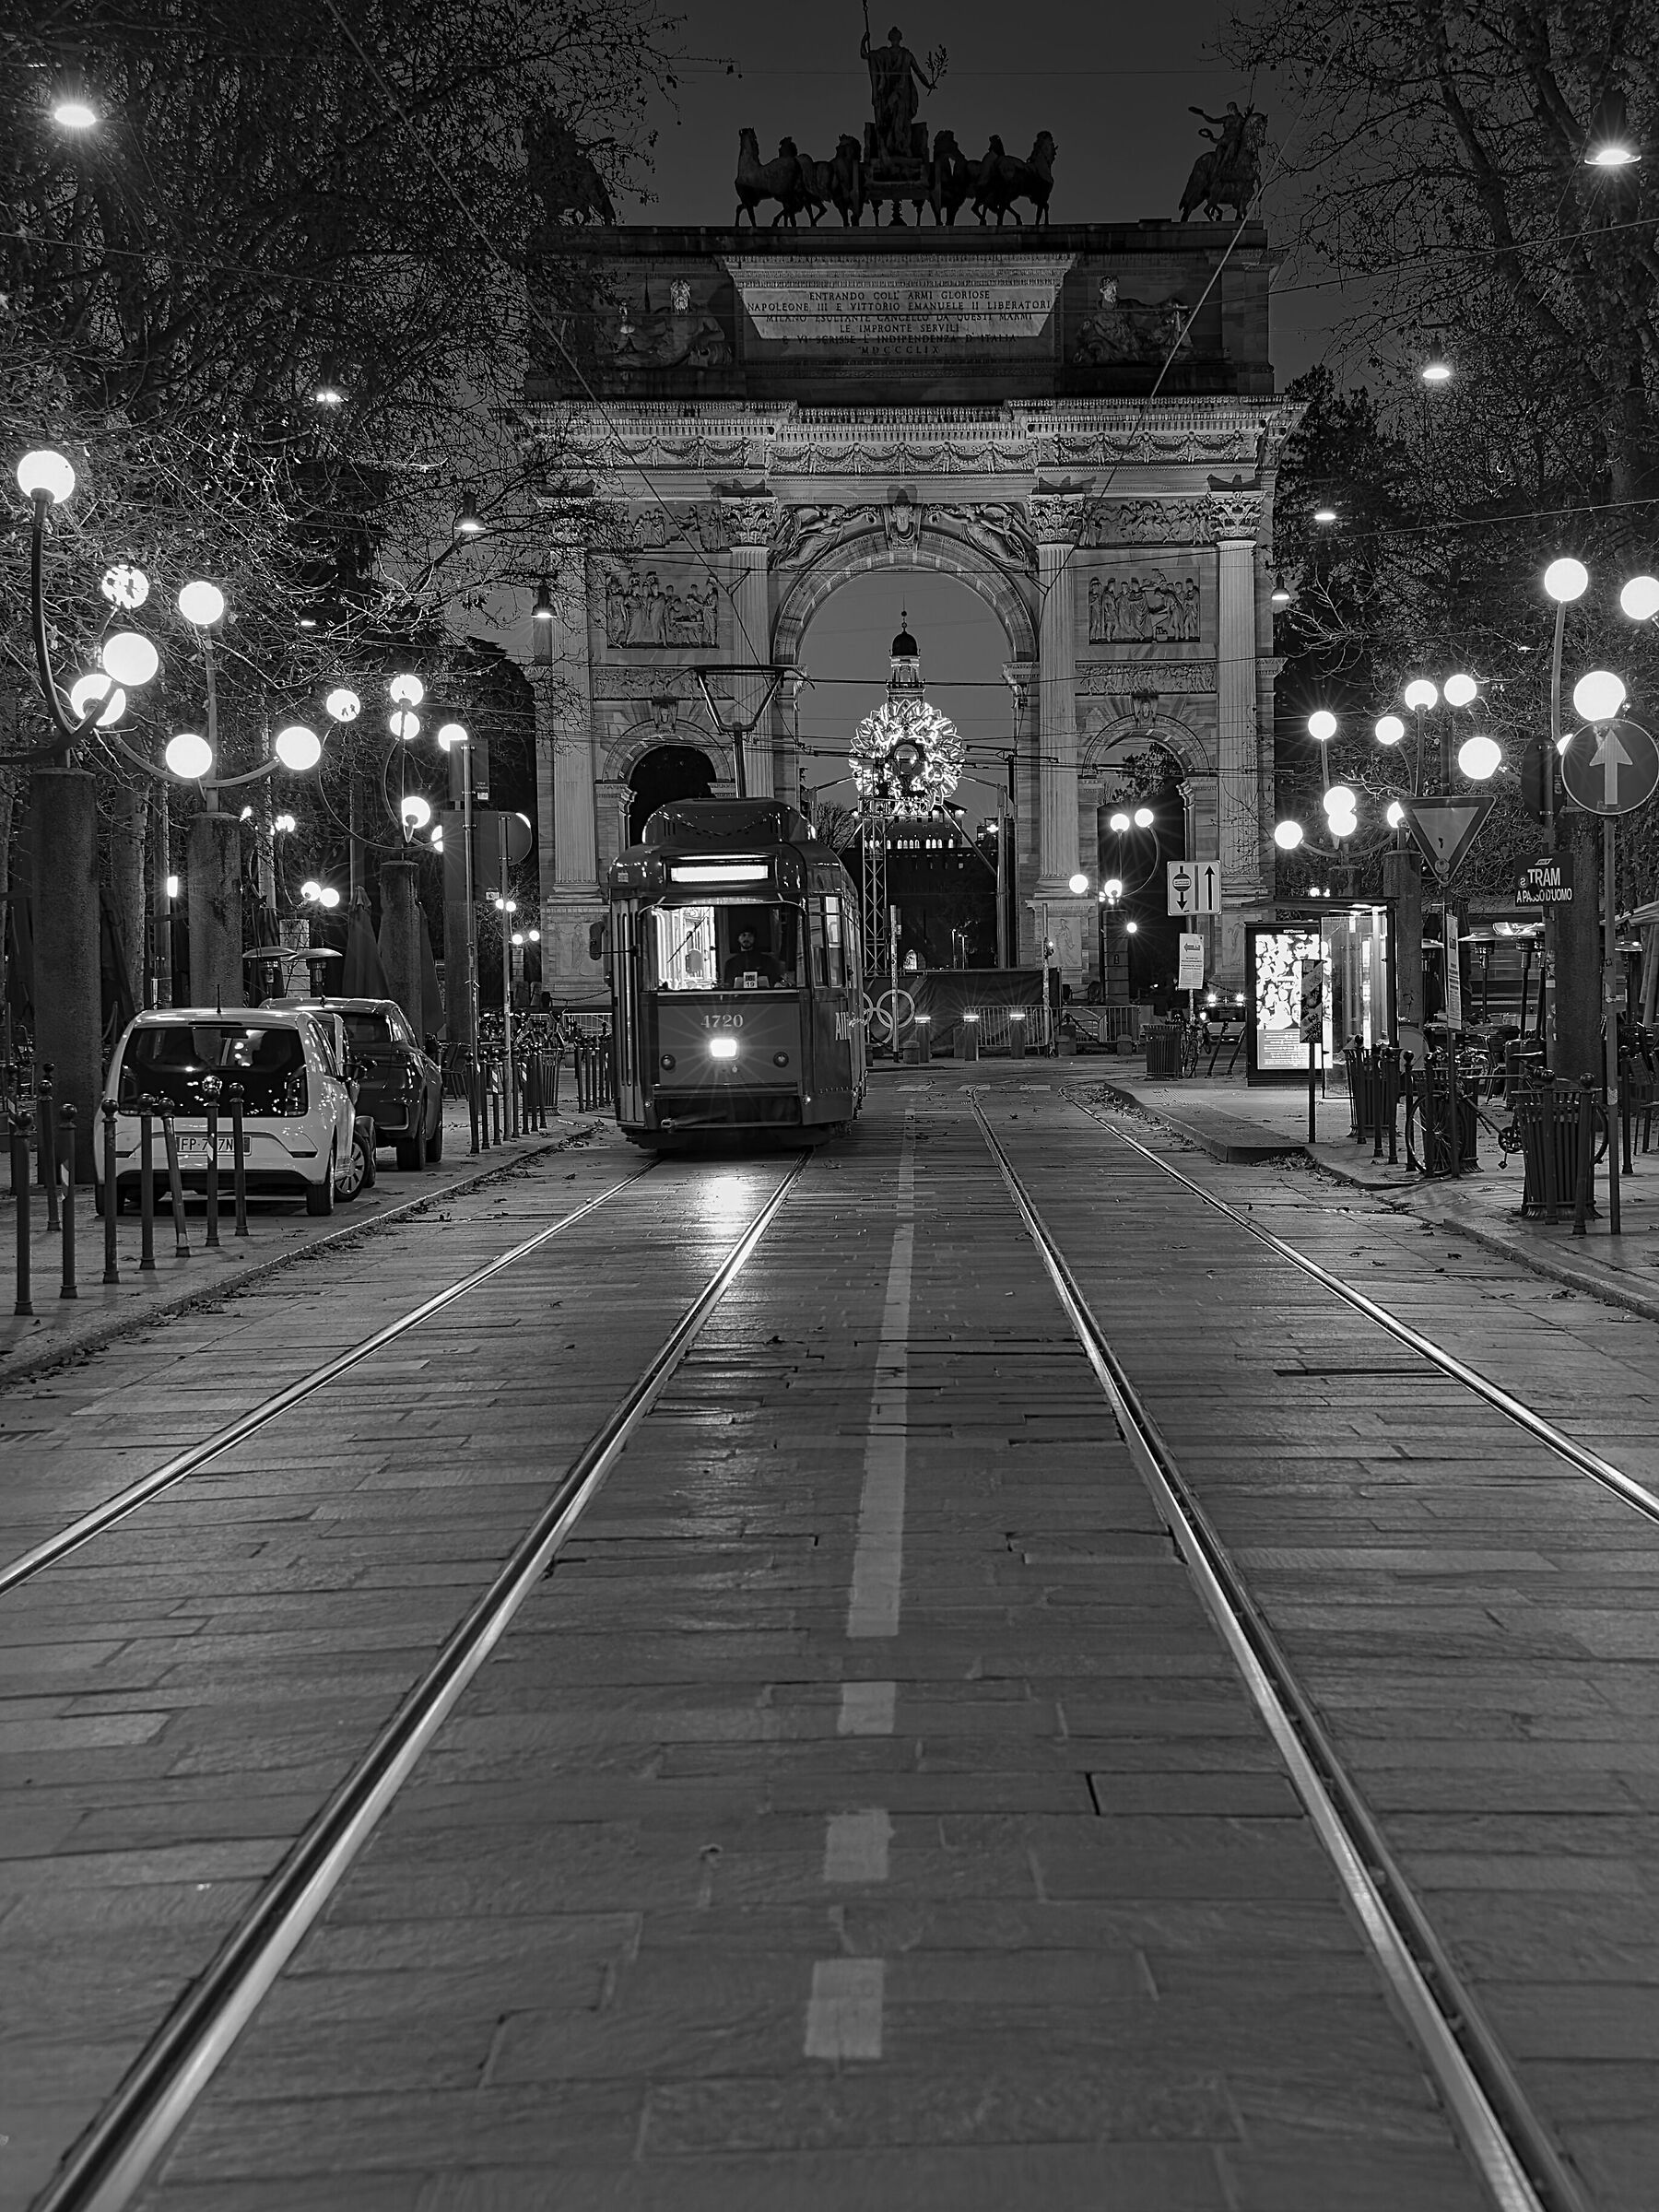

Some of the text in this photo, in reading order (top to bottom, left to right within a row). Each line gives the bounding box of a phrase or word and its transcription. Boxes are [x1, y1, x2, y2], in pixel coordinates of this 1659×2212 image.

[809, 291, 865, 300] ENTRANDO
[907, 290, 933, 300] ARMI
[940, 290, 990, 300] GLORIOSE
[747, 300, 1050, 312] NAPOLEONE III E VITTORIO EMANUELE II LIBERATORI
[840, 324, 959, 333] LE IMPRONTE SERVILI
[1527, 867, 1560, 887] TRAM
[1516, 890, 1522, 903] A
[700, 1014, 744, 1029] 4720
